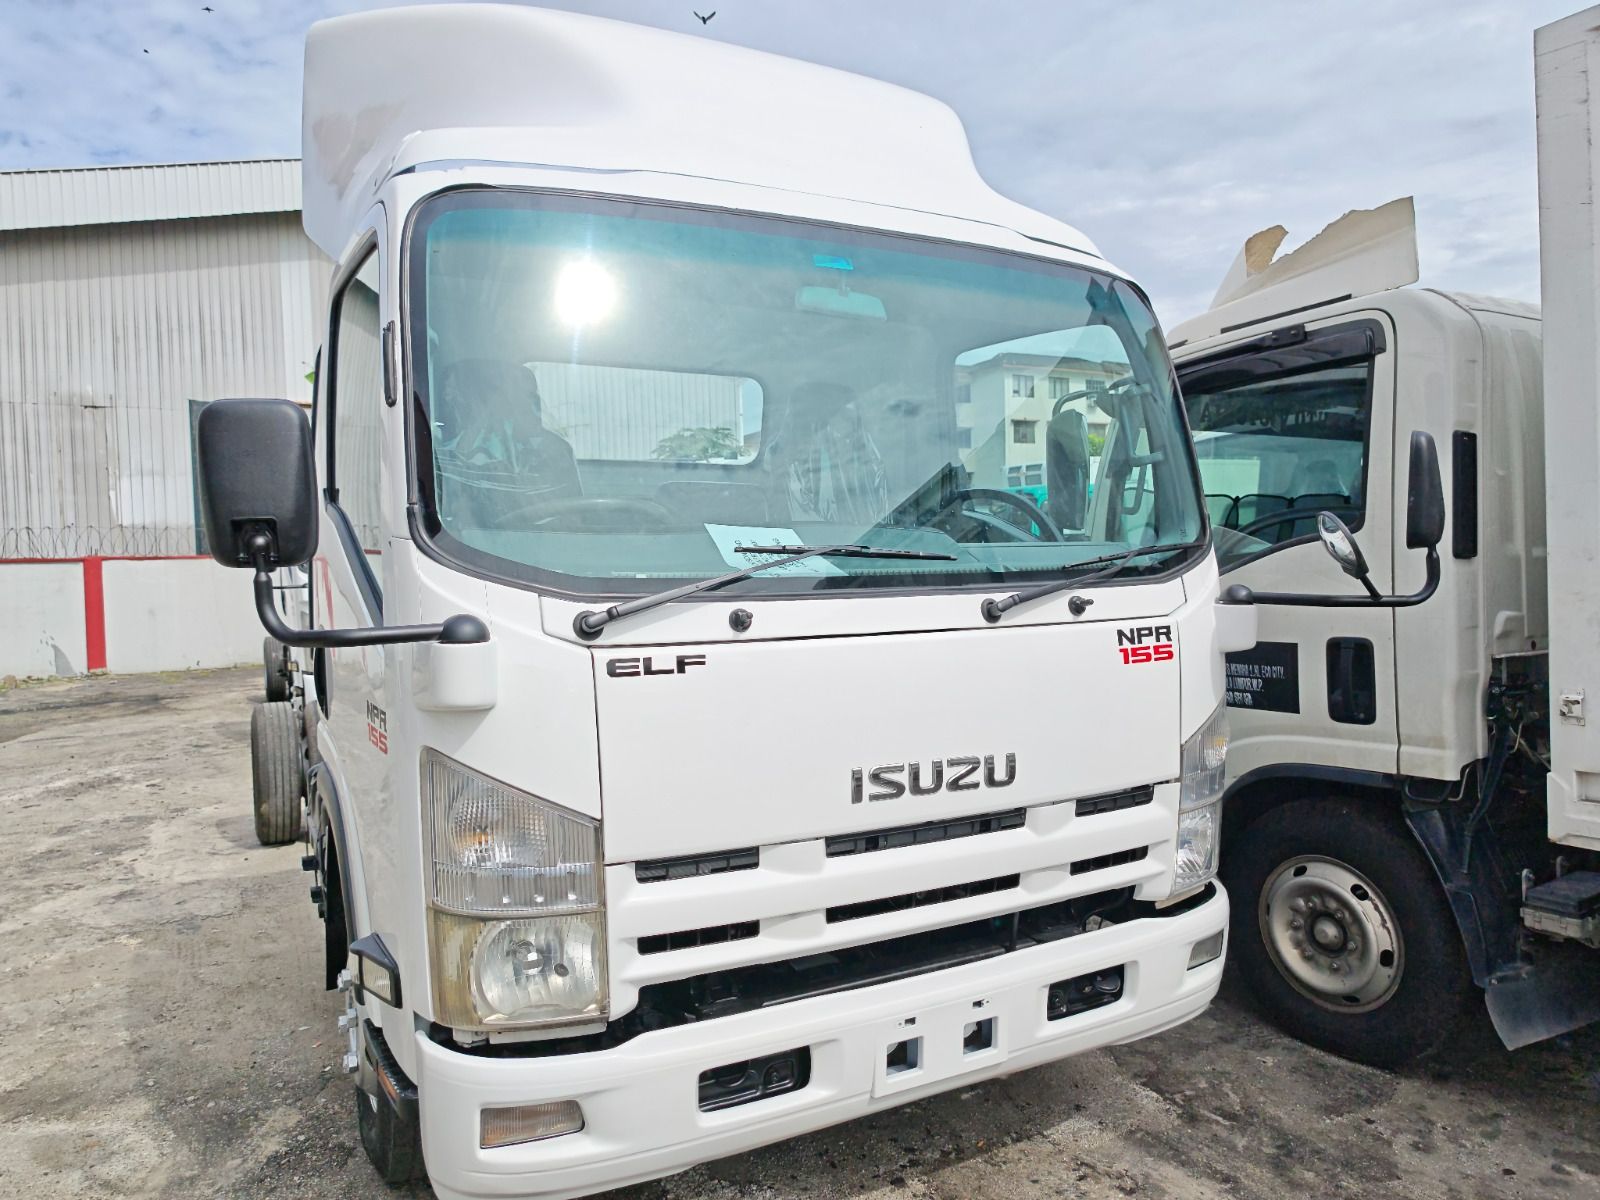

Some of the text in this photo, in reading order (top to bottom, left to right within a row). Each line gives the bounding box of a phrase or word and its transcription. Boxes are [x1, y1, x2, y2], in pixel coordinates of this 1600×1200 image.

[1117, 625, 1172, 646] NPR
[606, 654, 706, 678] ELF
[1119, 644, 1174, 664] 155
[367, 699, 387, 733] NPR
[368, 722, 388, 755] 155
[851, 752, 1017, 805] ISUZU
